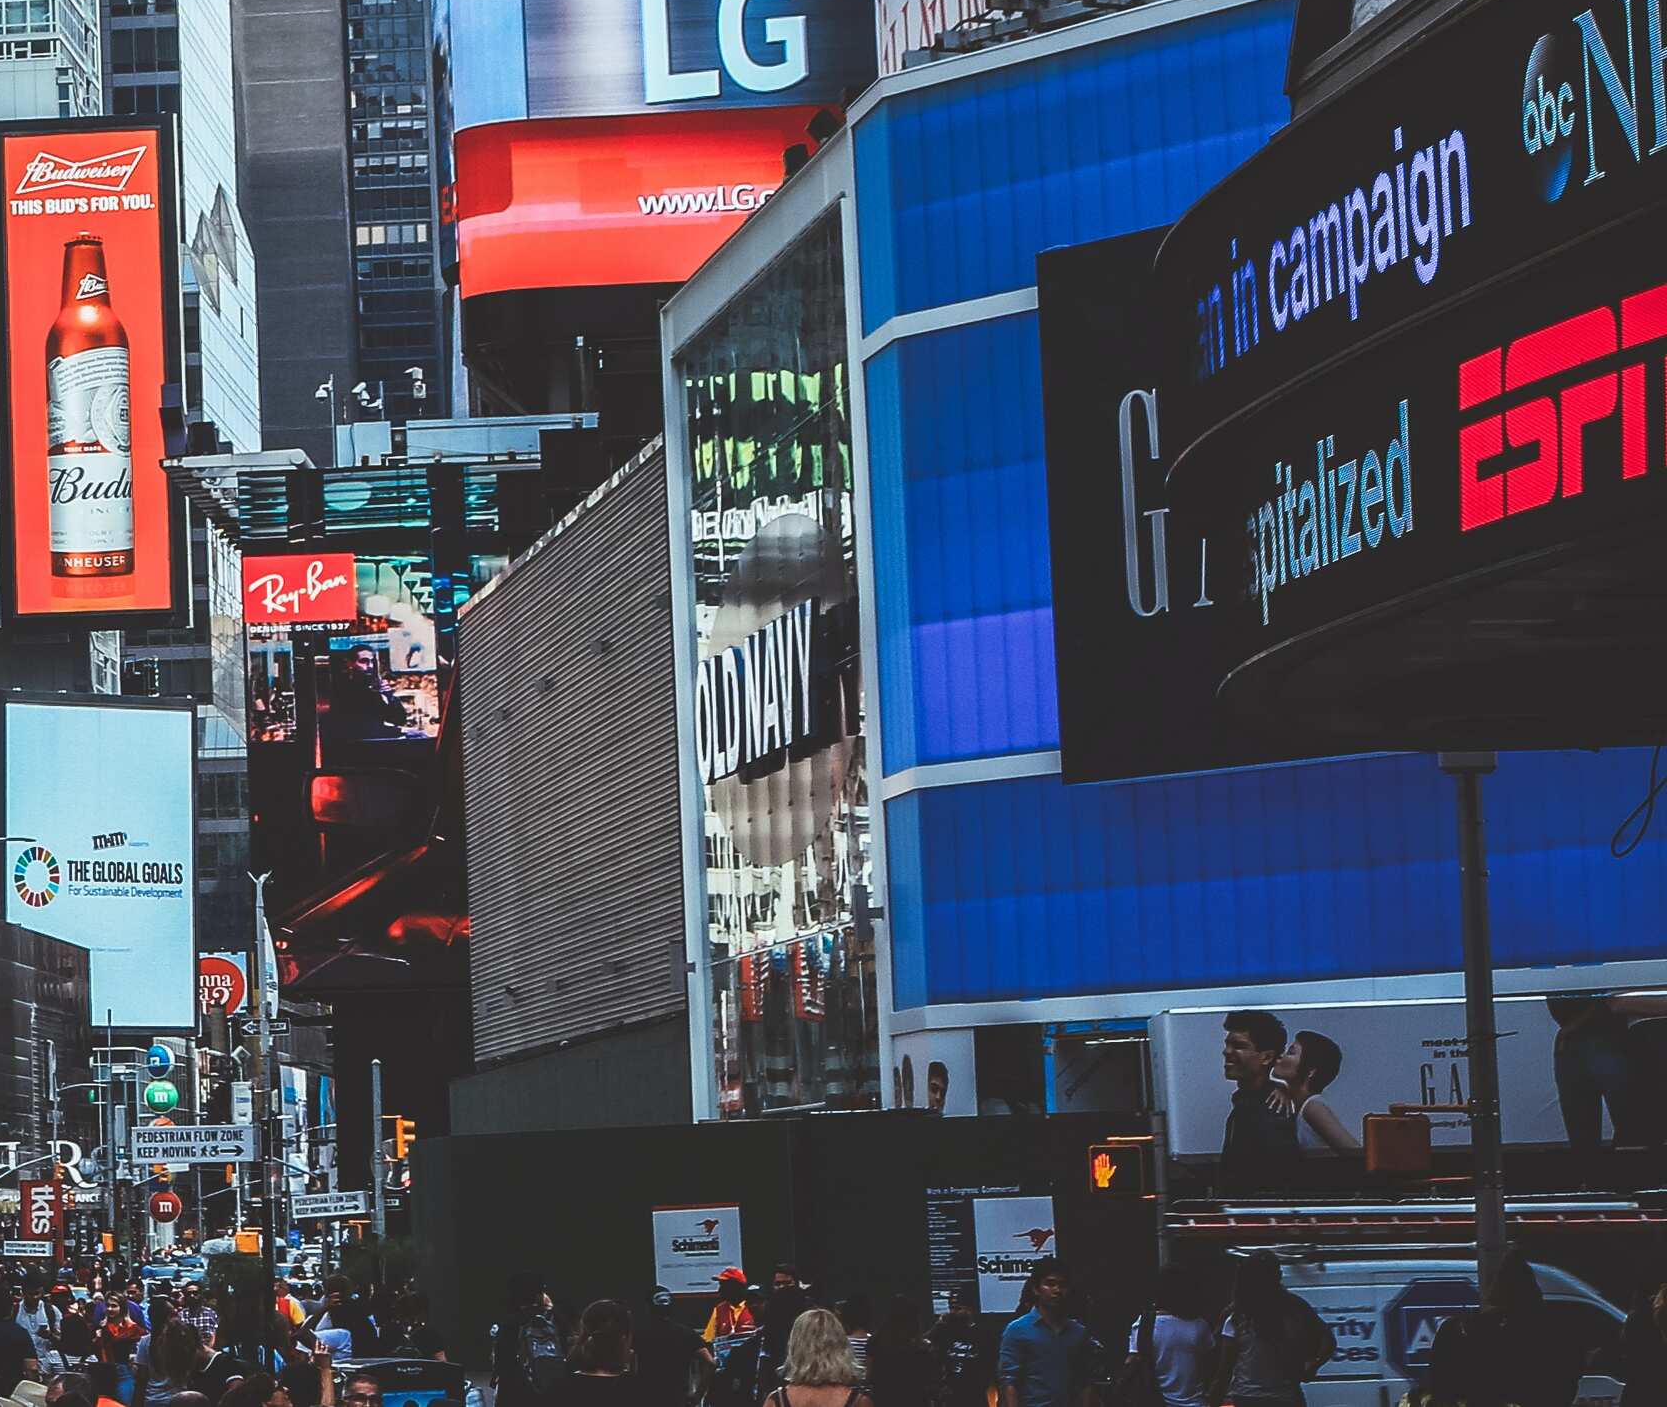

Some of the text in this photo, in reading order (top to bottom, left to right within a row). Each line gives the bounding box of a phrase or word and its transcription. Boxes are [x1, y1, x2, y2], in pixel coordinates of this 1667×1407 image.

[1521, 74, 1577, 156] abc
[28, 155, 131, 184] Budweiser
[10, 193, 155, 216] THIS BUD'S FOR YOU.
[1231, 126, 1474, 357] in campaign
[1458, 284, 1667, 533] ESPN
[249, 560, 348, 613] Ray-Ban
[250, 623, 350, 633] GENUINE SINCE 1937
[696, 597, 817, 785] OLD NAVY
[67, 860, 183, 884] THE GLOBAL GOALS
[68, 885, 183, 899] For Sustainable Development
[1419, 1062, 1466, 1106] GA
[136, 1128, 244, 1144] PEDESTRIAN FLOW ZONE
[136, 1145, 196, 1158] KEEP MOVING
[30, 1184, 56, 1235] tkts
[294, 1196, 328, 1206] PEDESTRIAN
